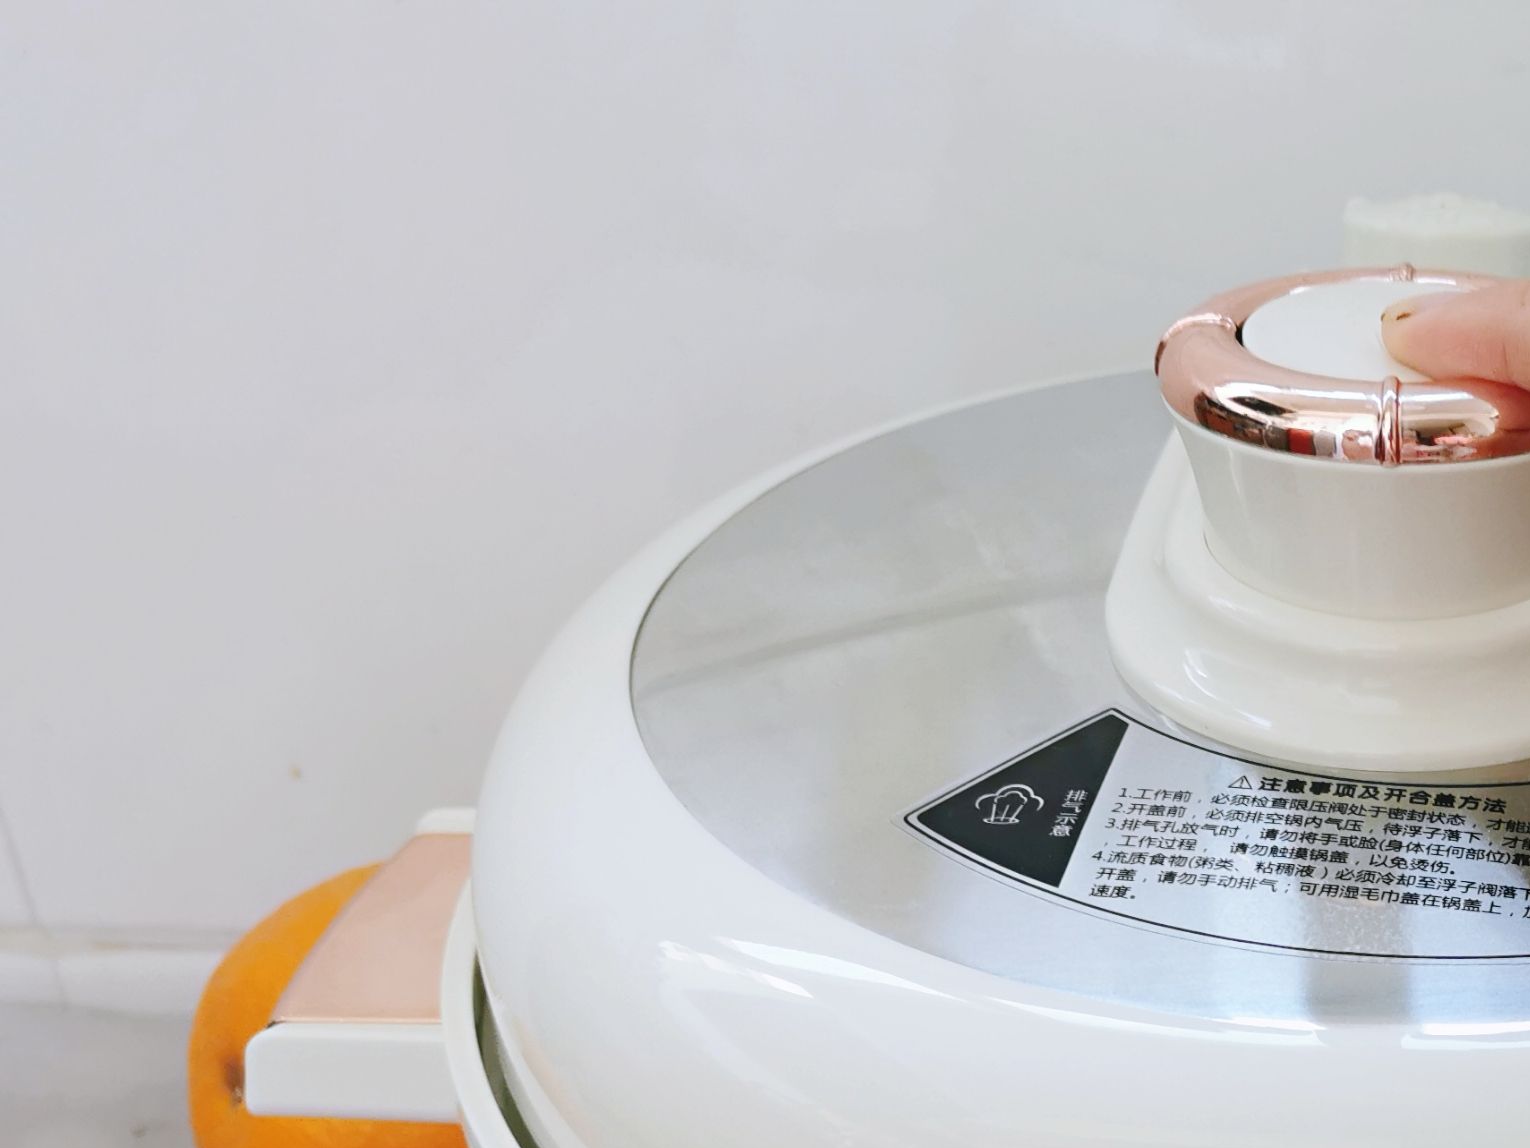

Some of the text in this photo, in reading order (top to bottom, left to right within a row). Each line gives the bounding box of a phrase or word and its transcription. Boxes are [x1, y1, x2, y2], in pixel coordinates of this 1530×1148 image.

[1048, 789, 1088, 836] 排气示意
[1258, 776, 1508, 815] 注意事项及开合盖方法
[1089, 884, 1136, 900] 速度。
